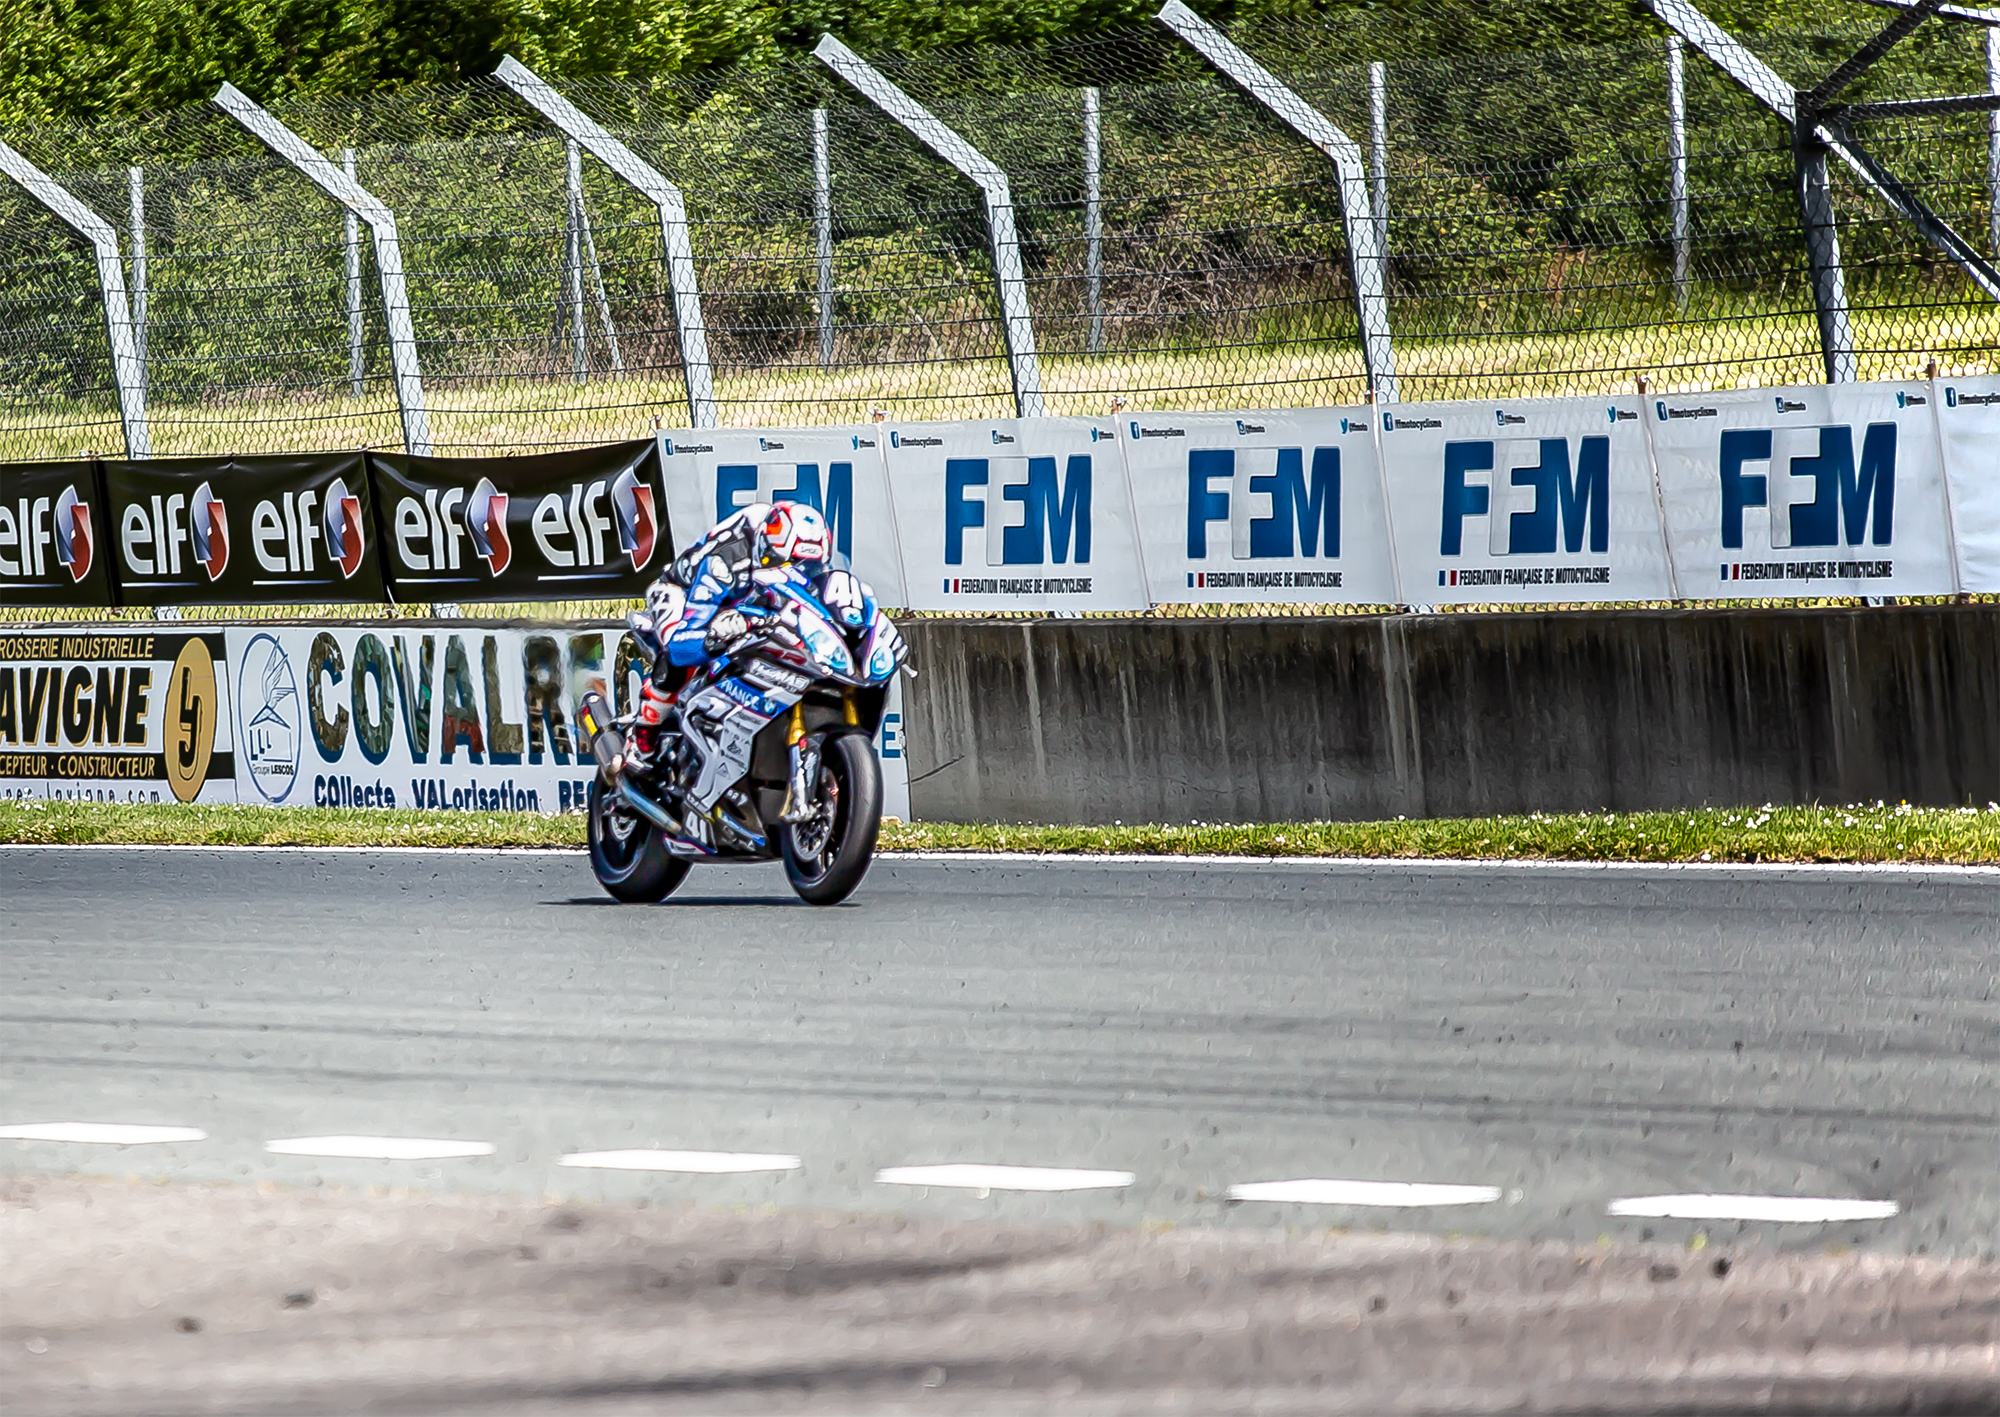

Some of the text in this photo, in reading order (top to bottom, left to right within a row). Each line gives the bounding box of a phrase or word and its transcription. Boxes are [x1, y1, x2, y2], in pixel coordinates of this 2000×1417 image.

[532, 481, 611, 567] elf
[945, 455, 1092, 566] FFM
[1187, 446, 1341, 559] FFM
[1440, 436, 1610, 556] FFM
[1720, 422, 1897, 549] FFM
[0, 493, 50, 576] elf
[121, 493, 187, 575] elf
[252, 490, 320, 572] elf
[395, 487, 465, 570] elf
[961, 579, 998, 594] FEDERATION
[1034, 579, 1042, 593] DE
[1044, 578, 1092, 593] MOTOCYCLISME
[1206, 573, 1245, 588] FEDERATION
[1284, 573, 1293, 587] DE
[1294, 572, 1342, 588] MOTOCYCLISME
[1459, 569, 1501, 586] FEDERATION
[1544, 568, 1554, 585] DE
[1555, 567, 1610, 583] MOTOCYCLISME
[1741, 563, 1784, 580] FEDERATION
[1827, 562, 1837, 578] DE
[1838, 561, 1892, 579] MOTOCYCLISME
[61, 637, 154, 659] INDUSTRIELLE
[0, 664, 153, 747] AVIGNE
[58, 755, 155, 777] CONSTRUCTEUR
